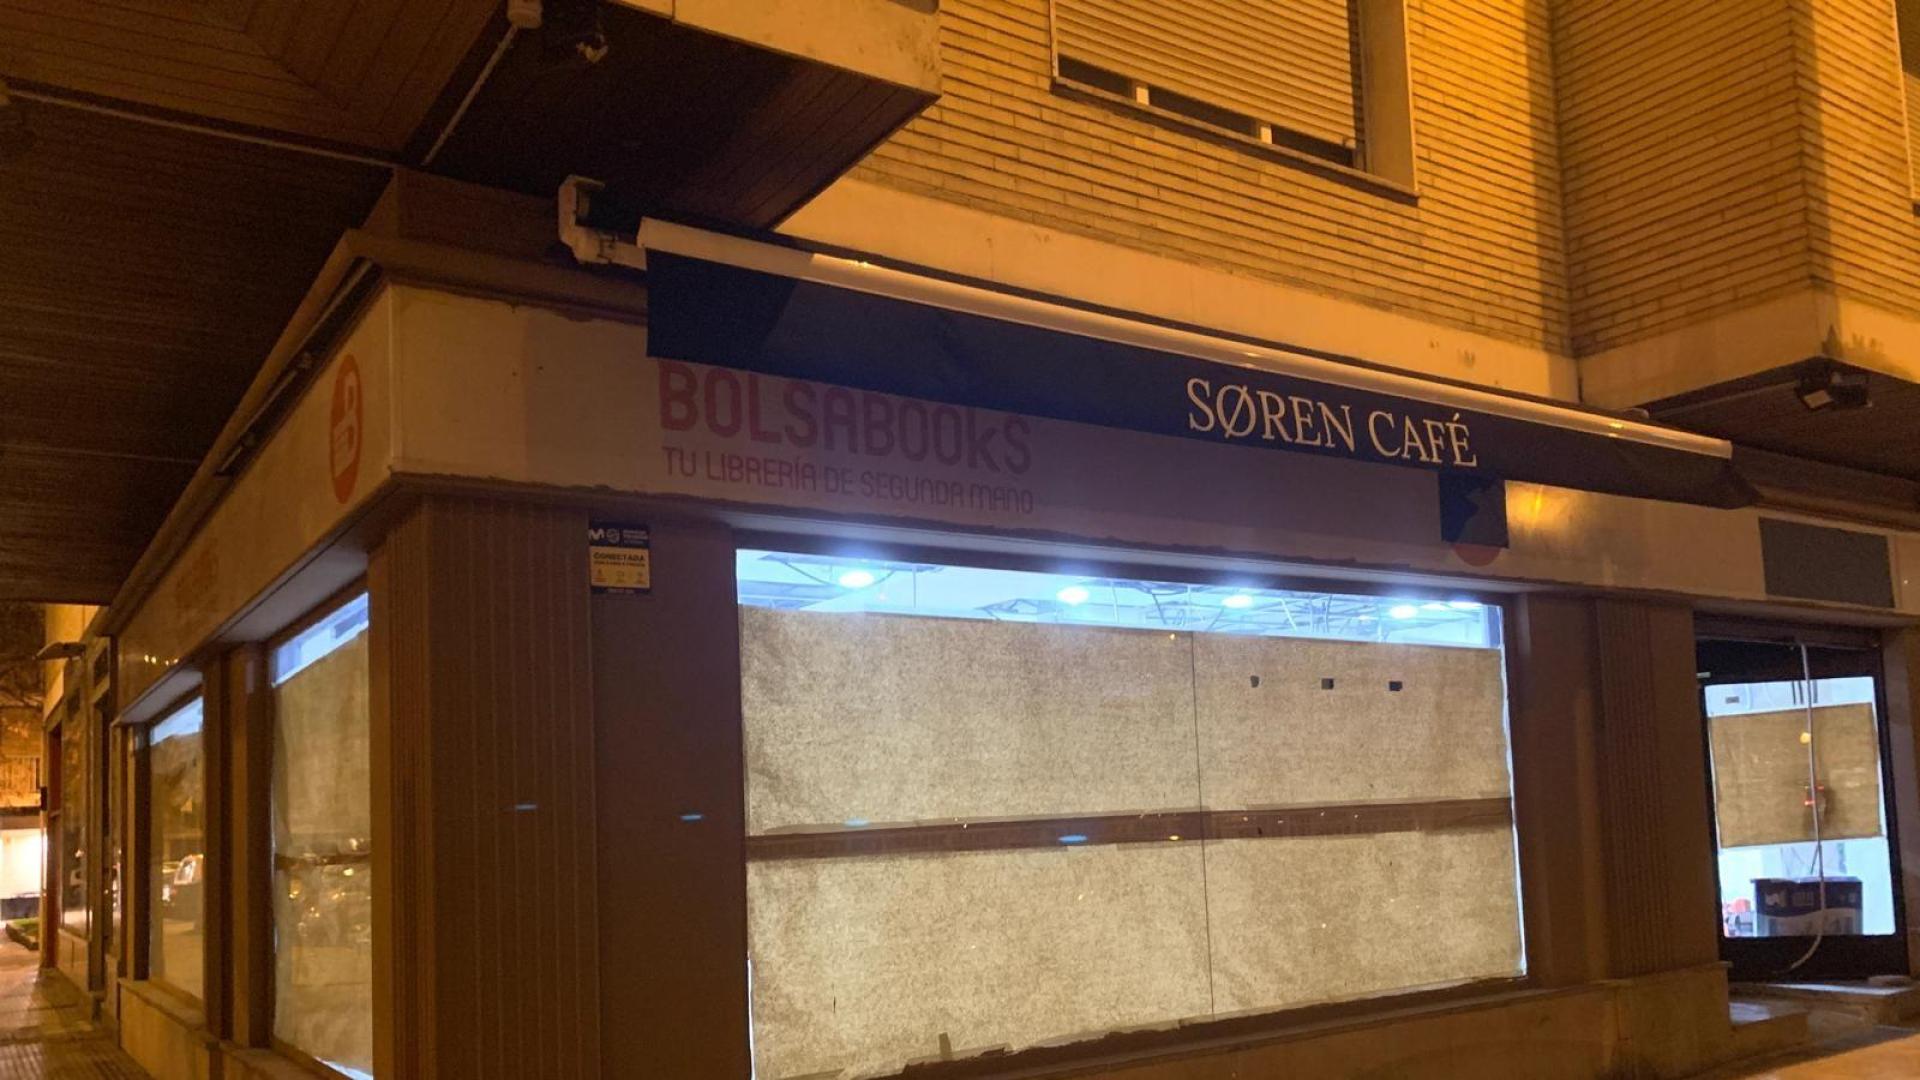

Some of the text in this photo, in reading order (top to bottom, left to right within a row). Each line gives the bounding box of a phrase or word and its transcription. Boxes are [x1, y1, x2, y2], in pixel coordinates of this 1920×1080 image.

[1186, 377, 1478, 468] SØREN CAFÉ
[662, 446, 697, 478] TU
[706, 450, 818, 493] LIBRERÍA
[824, 465, 854, 495] DE
[593, 552, 644, 561] CONECTADA
